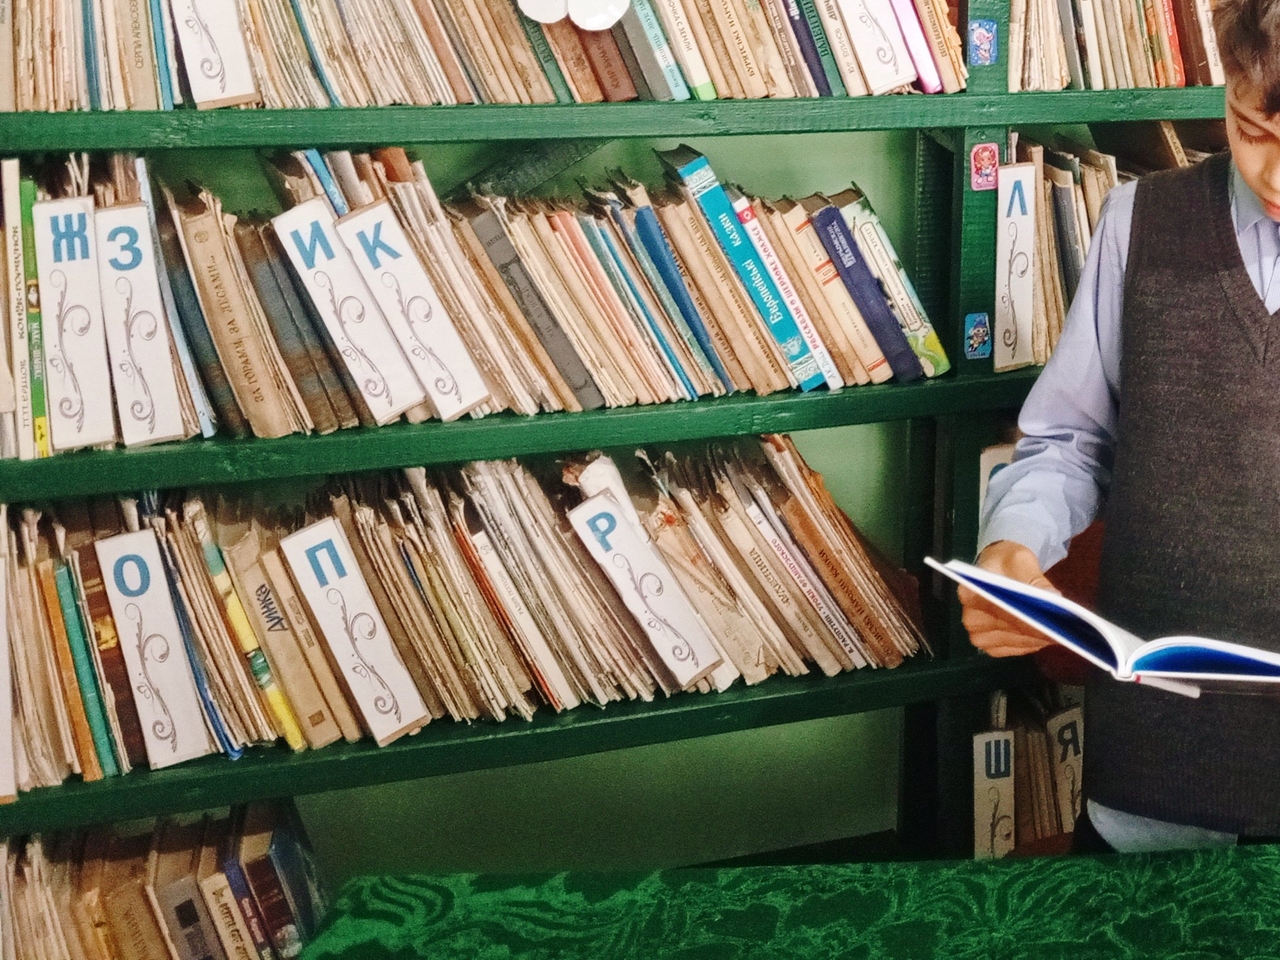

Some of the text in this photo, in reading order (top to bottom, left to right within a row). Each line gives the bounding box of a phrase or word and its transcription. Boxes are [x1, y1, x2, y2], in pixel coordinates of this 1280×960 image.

[677, 25, 692, 51] ЗЕМЛИ
[732, 29, 755, 77] БУРЯТСЬКІ
[1006, 180, 1028, 218] Л
[50, 212, 89, 263] Ж
[107, 226, 143, 271] З
[290, 220, 336, 270] И
[355, 220, 402, 270] К
[750, 224, 773, 260] ХОЛМСЕ
[716, 210, 787, 324] Європейські казки
[768, 259, 793, 299] ШЕРЛОКЕ
[586, 511, 617, 552] Р
[113, 554, 150, 596] О
[304, 539, 348, 588] П
[817, 548, 865, 615] НАРОДНІ КАЗКИ
[252, 580, 288, 636] Динка
[770, 537, 850, 647] РАСПУТИН УРОКИ ФРАНЦУЗСКОГО
[986, 739, 1010, 778] Ш
[1057, 720, 1080, 763] Я
